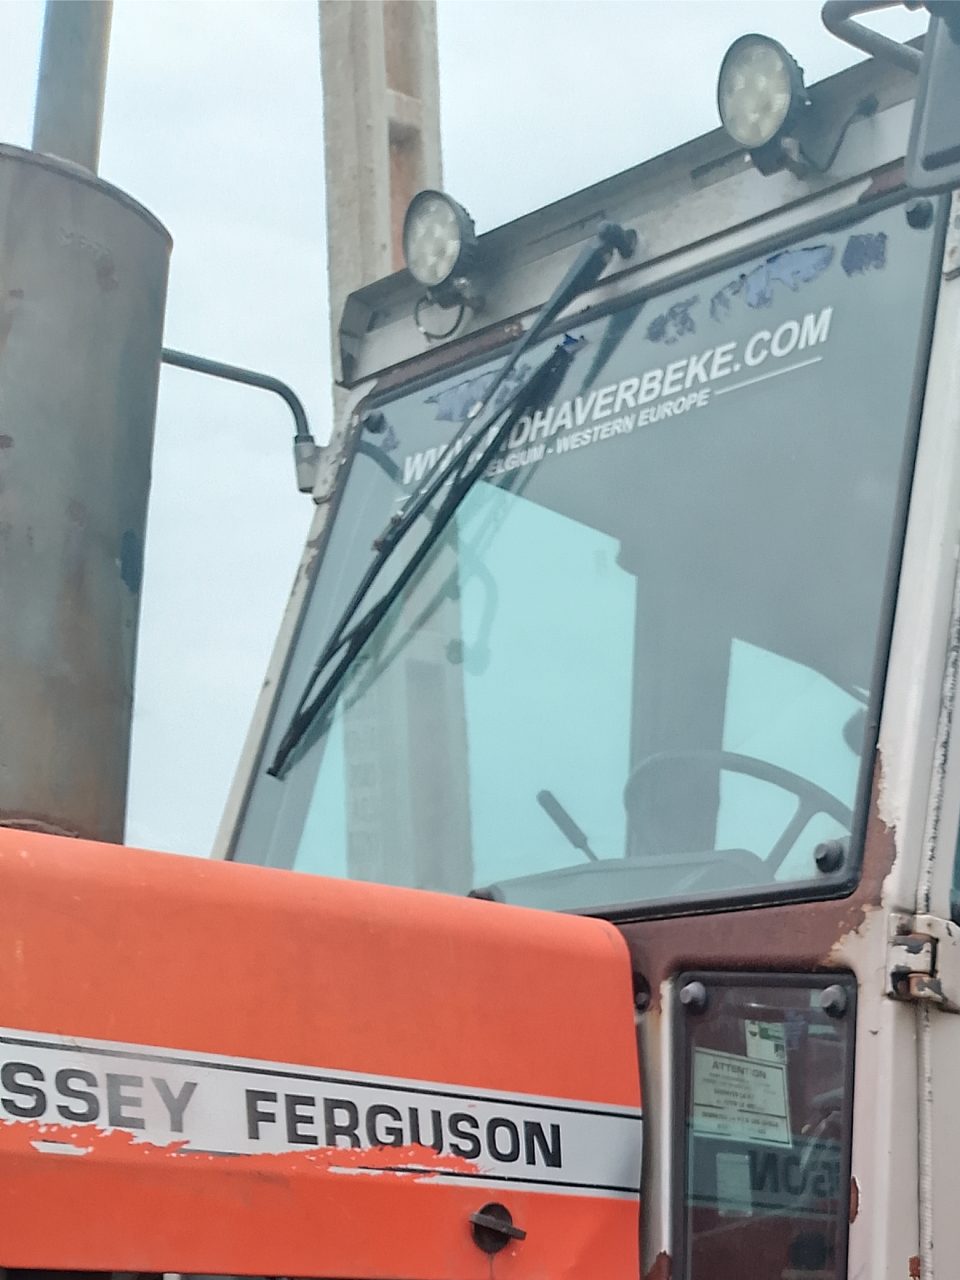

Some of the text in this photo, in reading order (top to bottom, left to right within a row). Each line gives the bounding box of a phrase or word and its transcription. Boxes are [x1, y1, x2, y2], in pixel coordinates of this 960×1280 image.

[478, 443, 547, 478] ELGIUM
[555, 412, 637, 454] WESTERN
[637, 387, 713, 429] EUROPE
[0, 1061, 563, 1169] SSEY FERGUSON
[711, 1060, 768, 1080] ATTENTON
